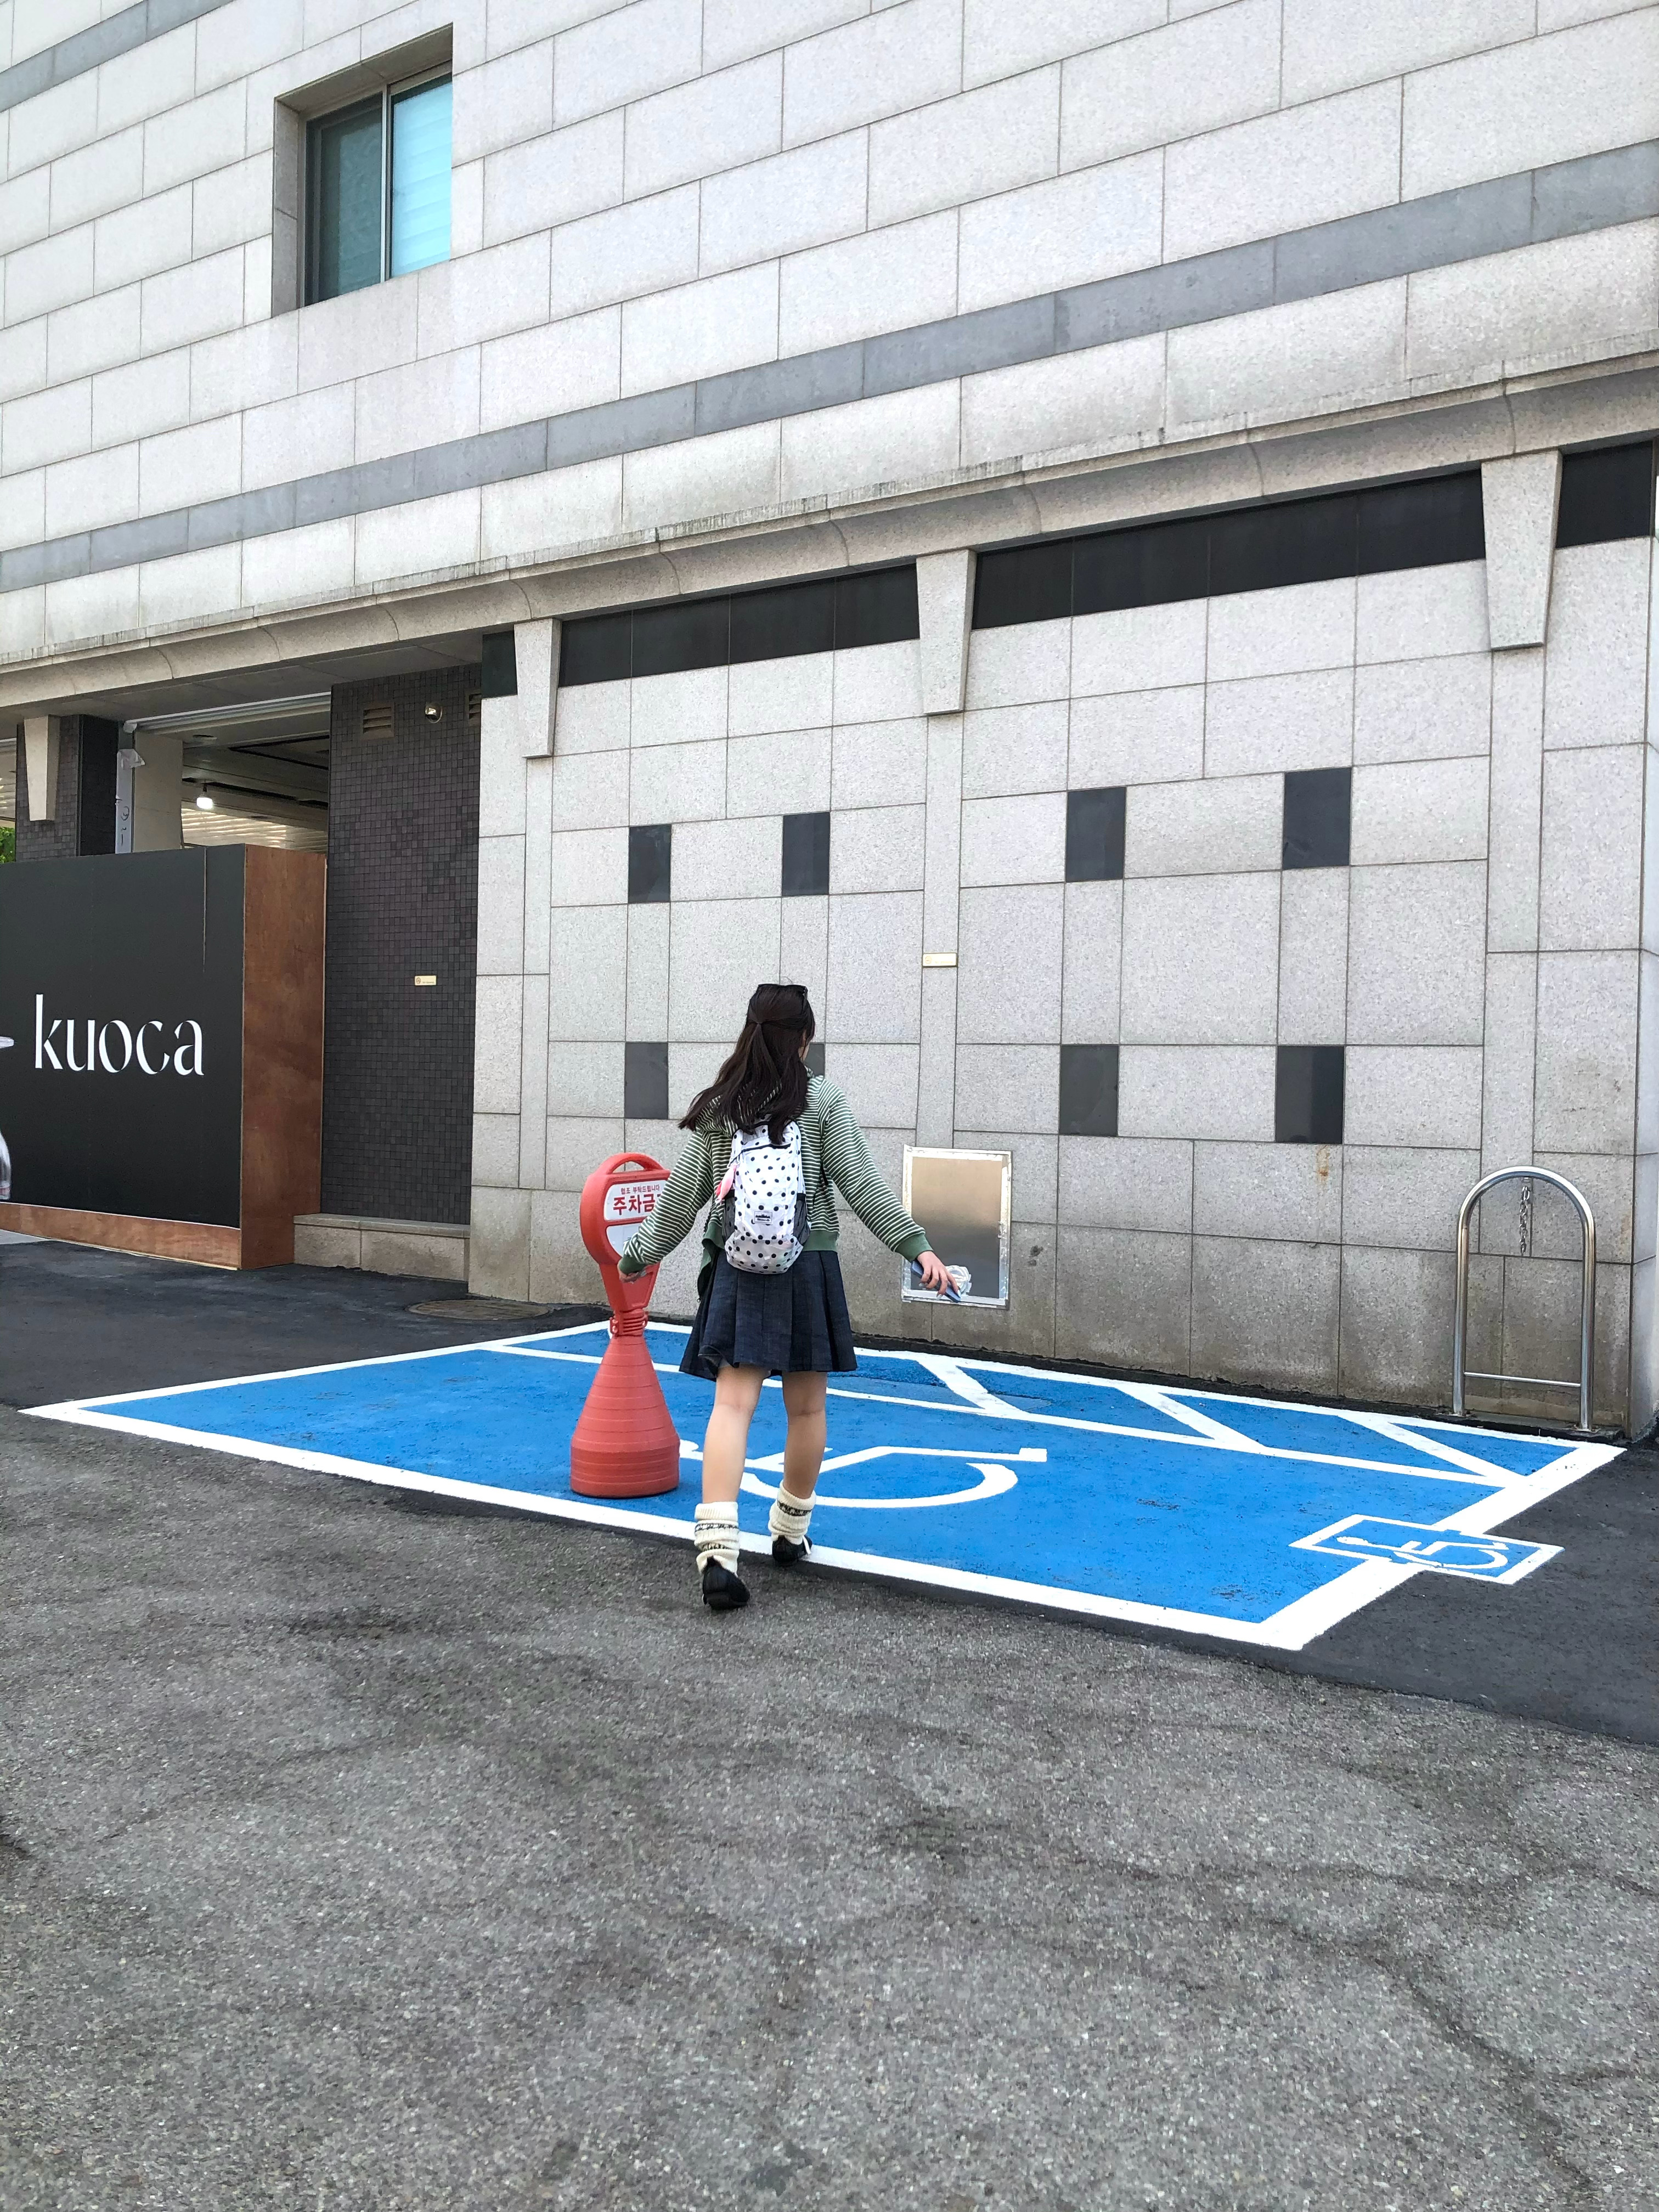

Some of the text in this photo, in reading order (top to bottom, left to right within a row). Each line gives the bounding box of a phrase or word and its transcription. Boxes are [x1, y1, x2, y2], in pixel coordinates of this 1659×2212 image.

[35, 994, 205, 1076] kuoca
[633, 1184, 660, 1194] 부탁드립니다
[613, 1193, 662, 1216] 주차금
